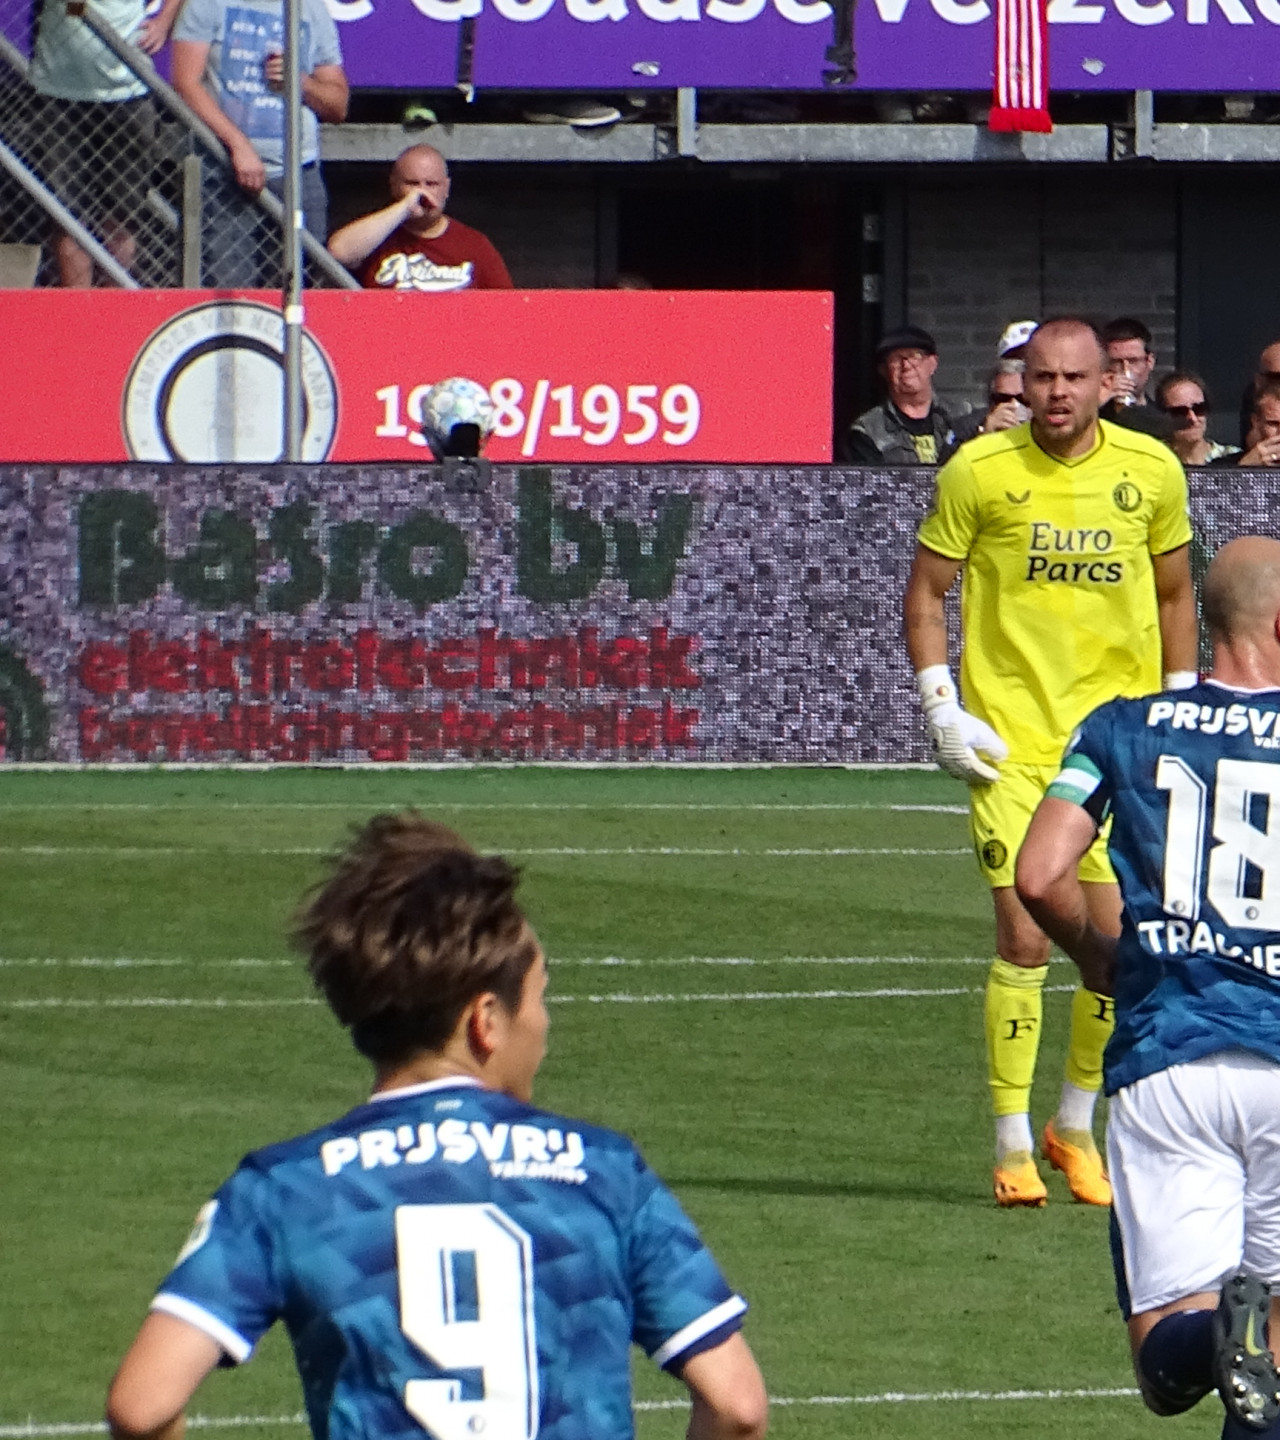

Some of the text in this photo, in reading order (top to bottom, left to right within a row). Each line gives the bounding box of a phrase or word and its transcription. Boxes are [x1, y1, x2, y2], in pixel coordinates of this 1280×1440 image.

[375, 378, 701, 457] 198/1959
[1030, 522, 1113, 553] Euro
[1025, 556, 1124, 584] Parcs
[1003, 1017, 1038, 1041] F
